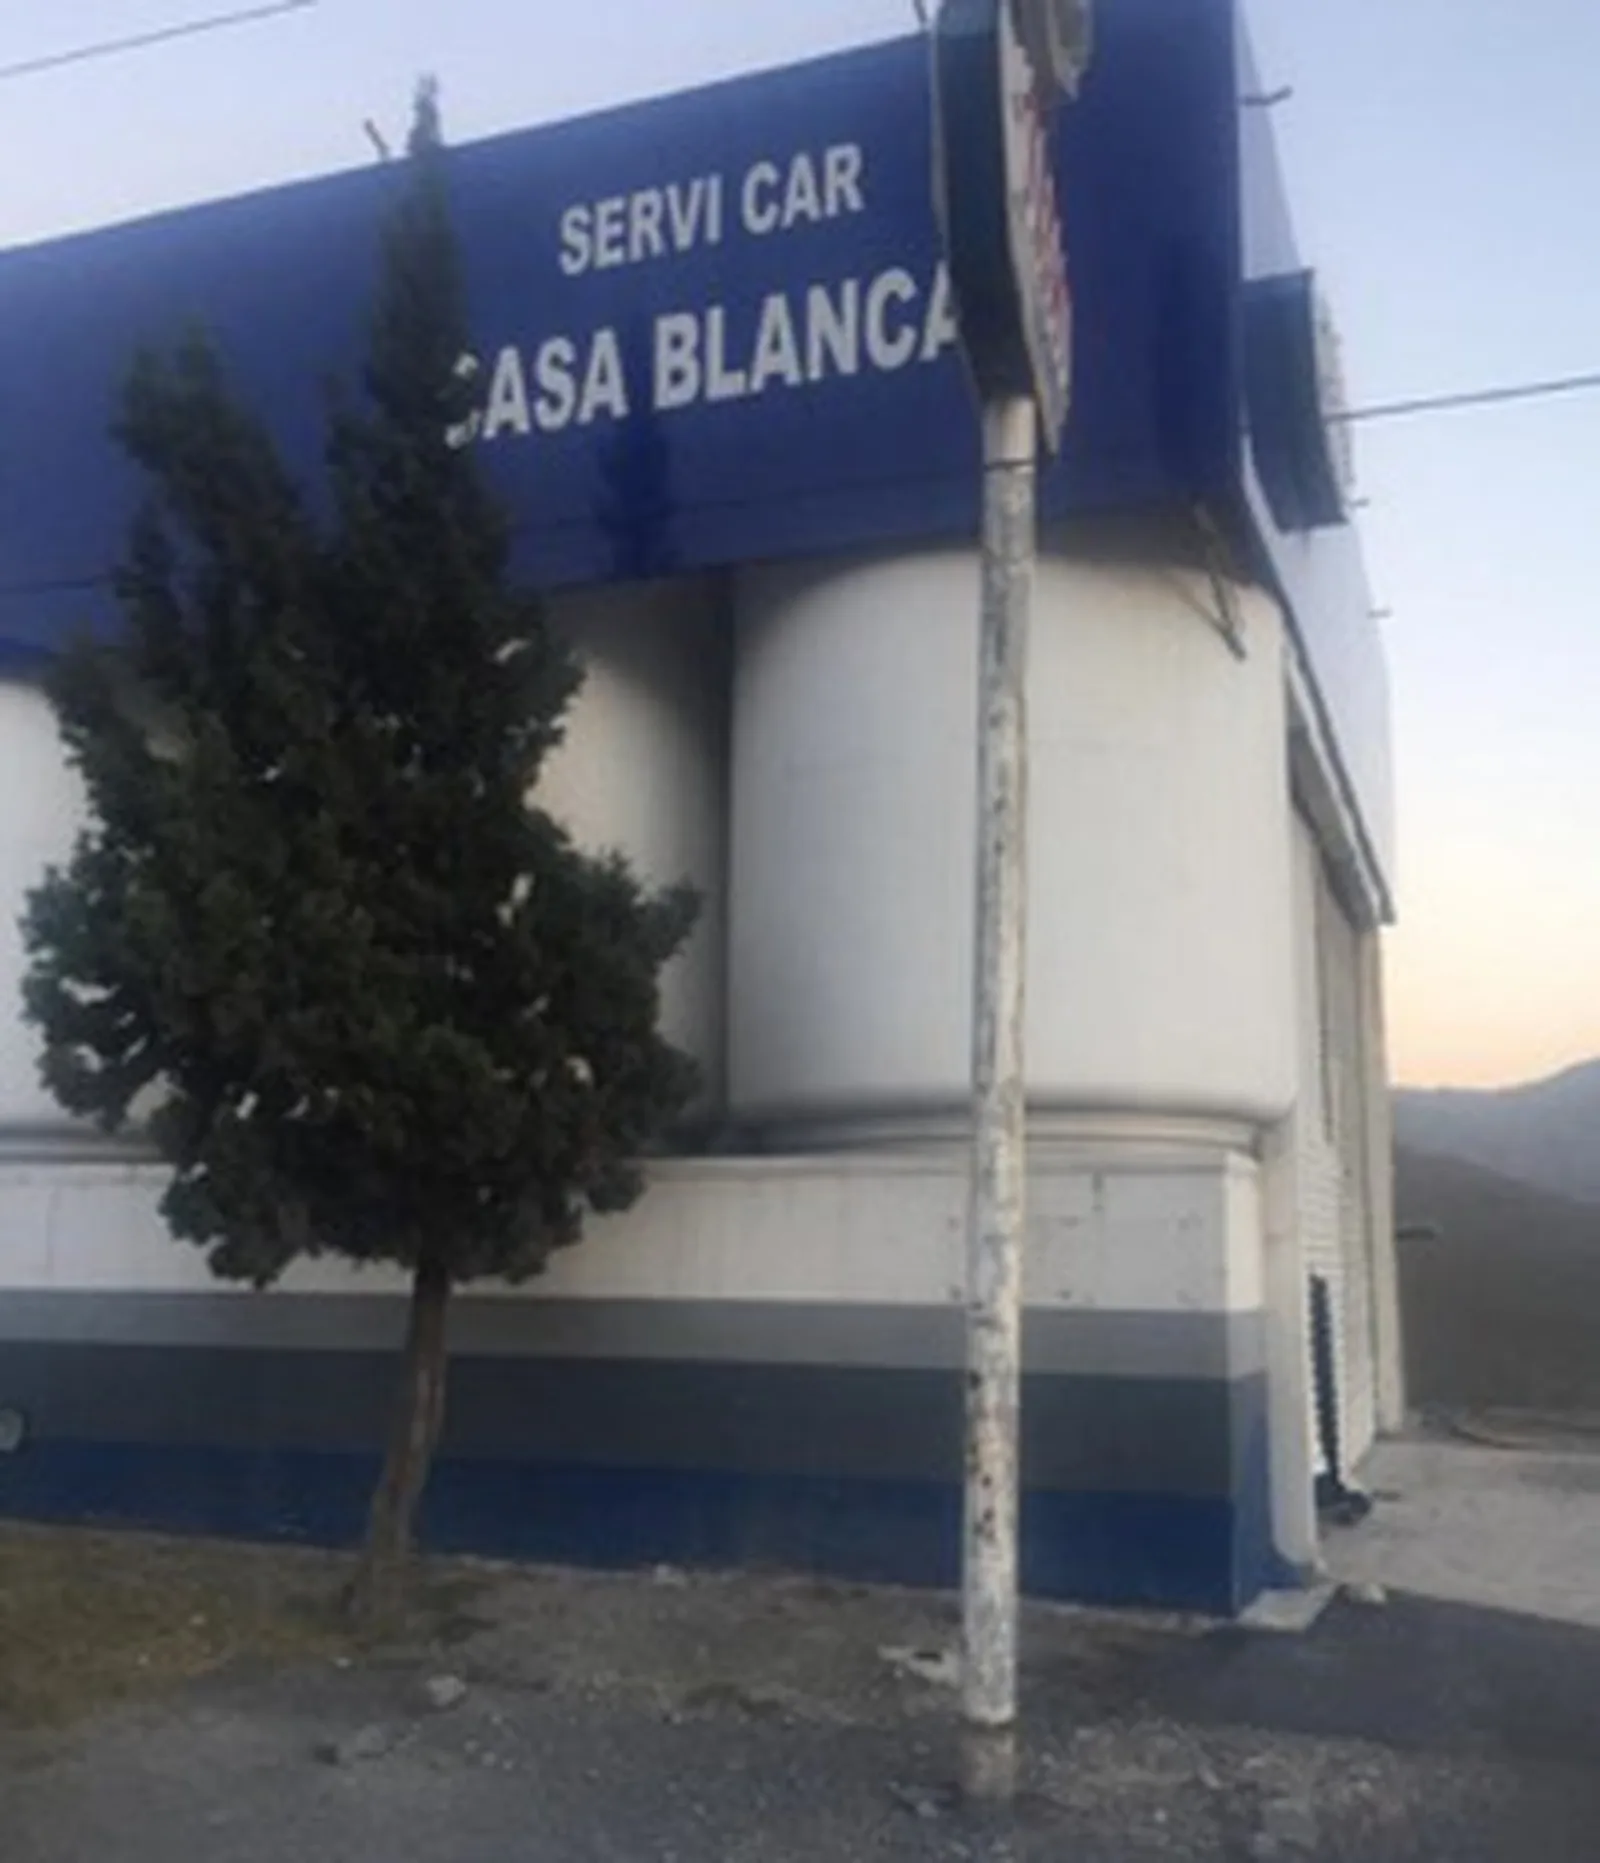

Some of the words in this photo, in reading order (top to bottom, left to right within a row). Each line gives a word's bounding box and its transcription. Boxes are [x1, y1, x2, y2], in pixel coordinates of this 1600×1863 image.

[558, 174, 722, 275] SERVI
[740, 143, 864, 234] CAR
[652, 260, 958, 410] BLANCA
